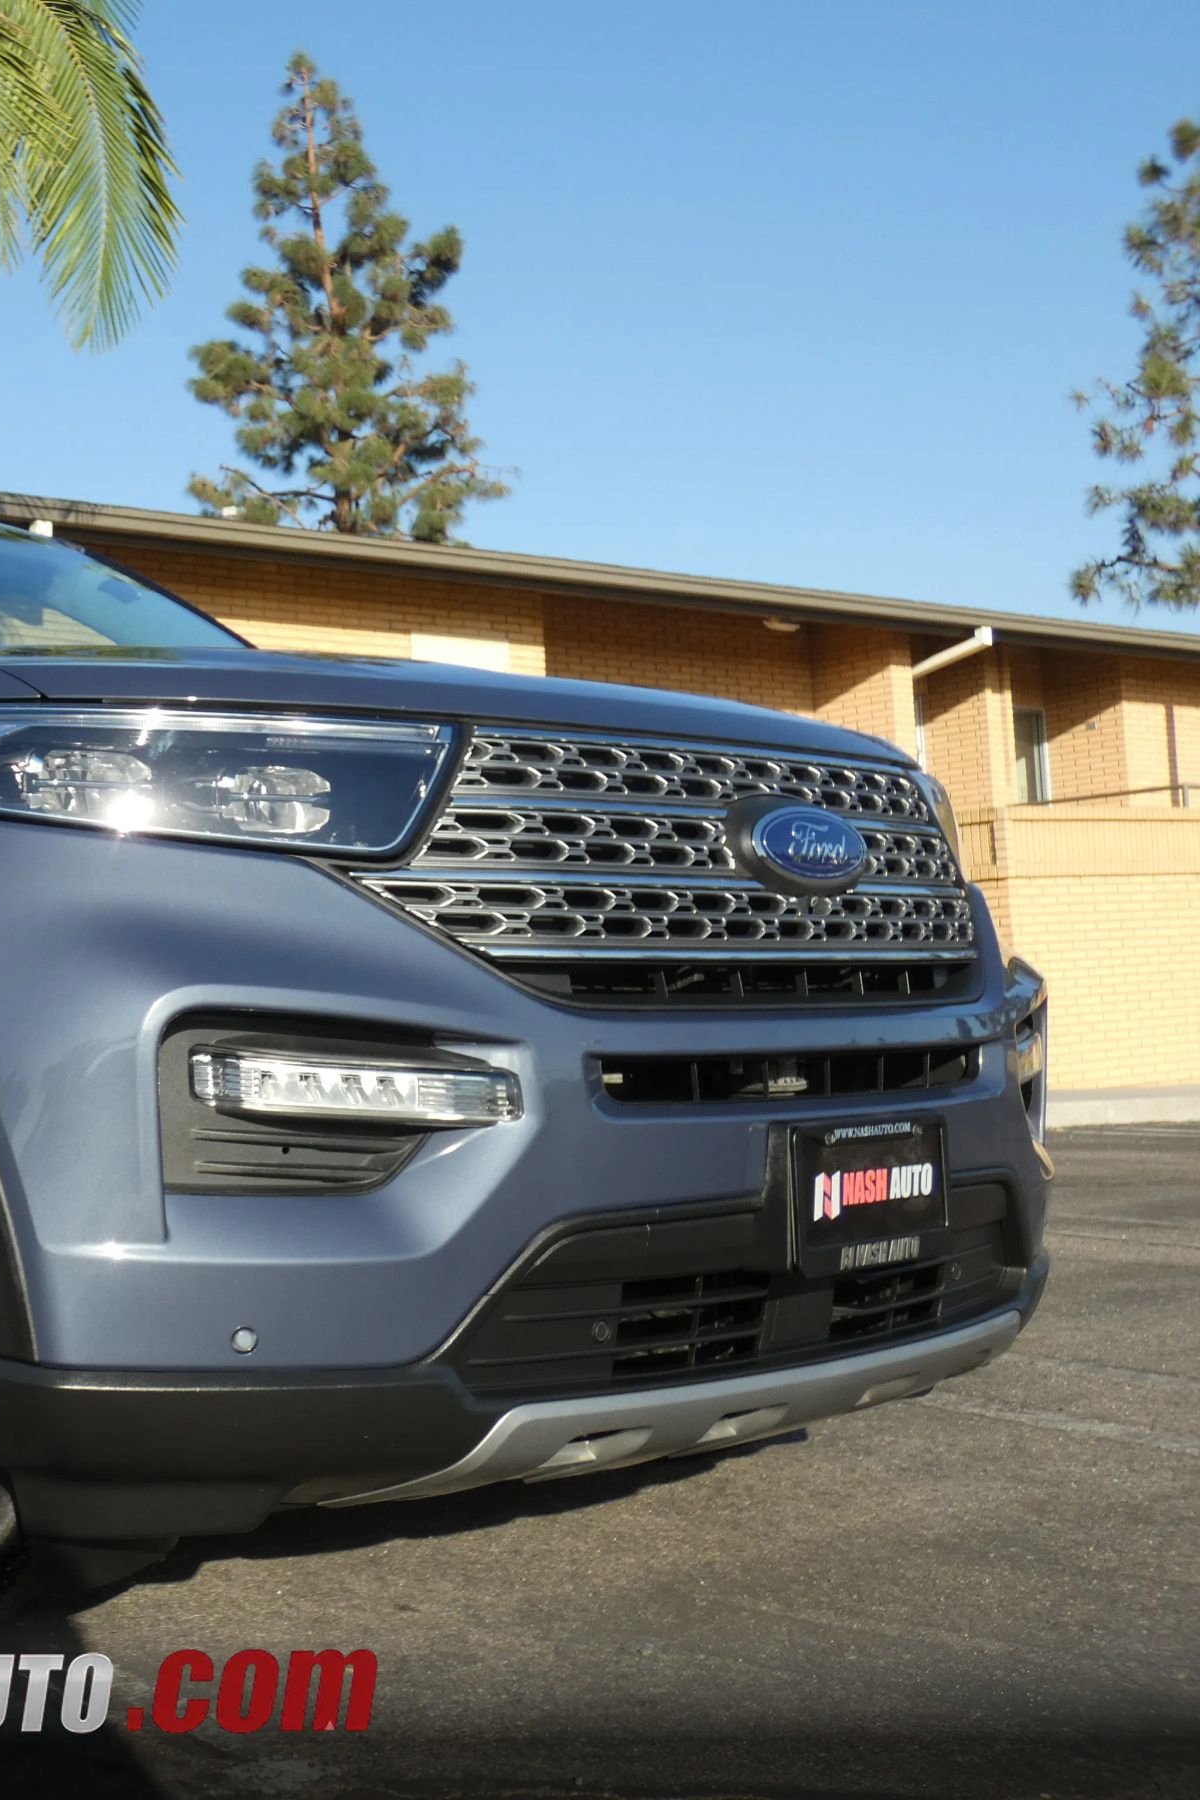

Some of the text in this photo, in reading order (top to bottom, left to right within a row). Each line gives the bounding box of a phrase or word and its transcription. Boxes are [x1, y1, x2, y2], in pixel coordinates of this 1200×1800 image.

[788, 821, 848, 865] Ford
[834, 1121, 911, 1139] WWW.NASHAUTO.COM
[842, 1167, 888, 1206] NASH
[889, 1162, 933, 1200] AUTO
[856, 1240, 888, 1267] NASH
[888, 1235, 920, 1262] AUTO
